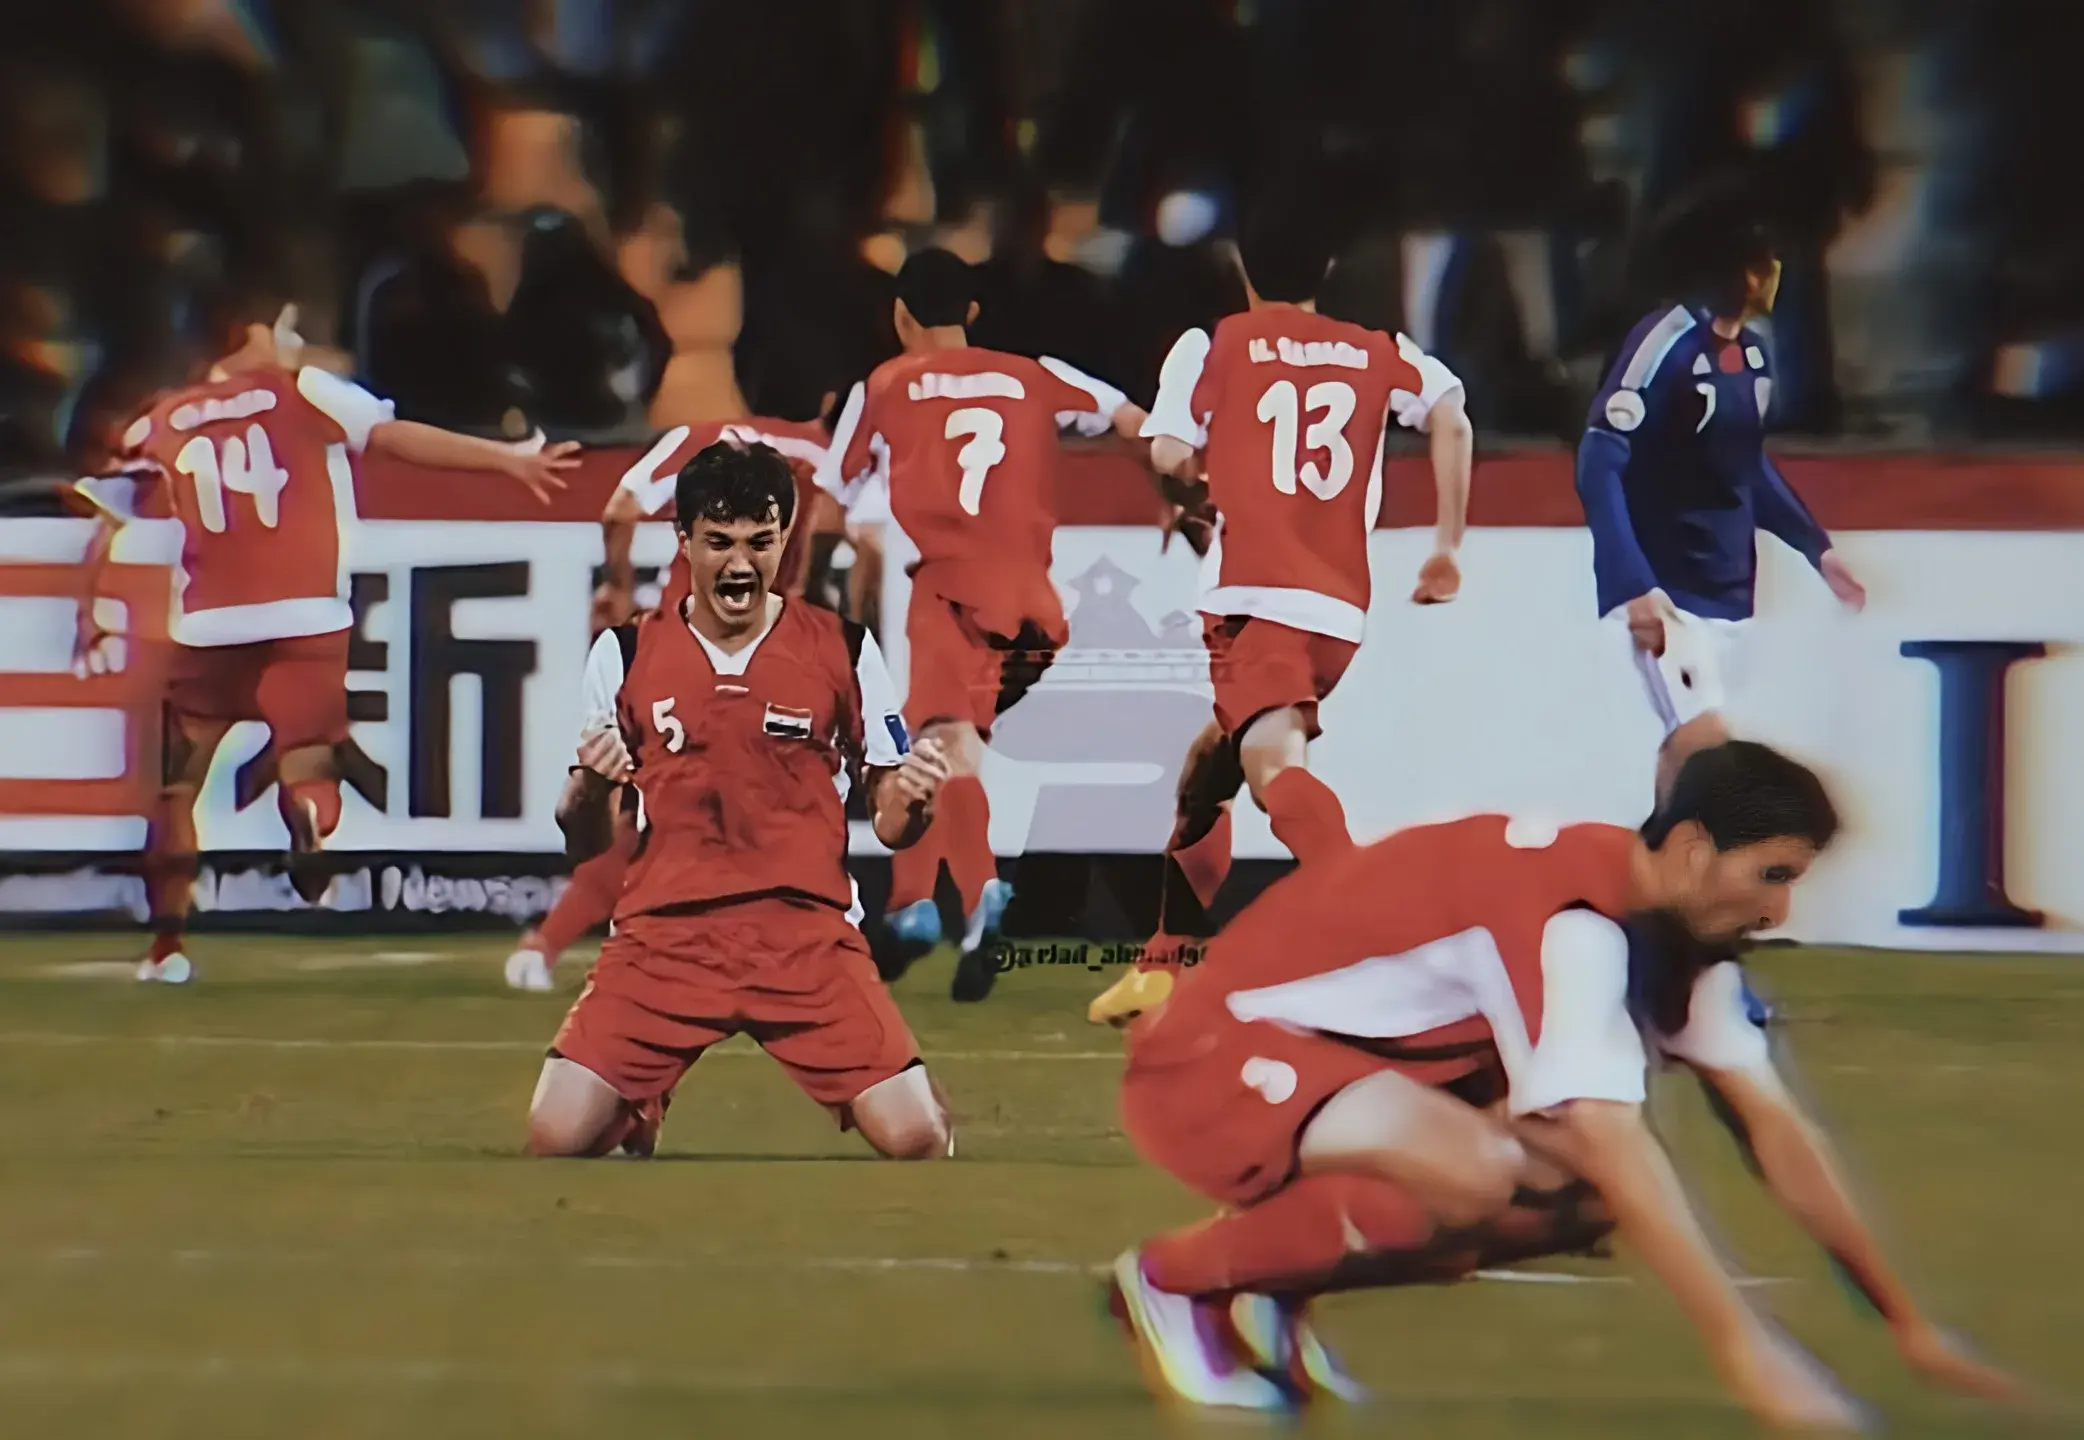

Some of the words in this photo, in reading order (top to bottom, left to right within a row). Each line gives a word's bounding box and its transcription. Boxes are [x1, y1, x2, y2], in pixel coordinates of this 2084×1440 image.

[175, 423, 289, 533] 14
[944, 406, 1006, 517] 7
[1256, 379, 1357, 501] 13
[652, 696, 686, 754] 5
